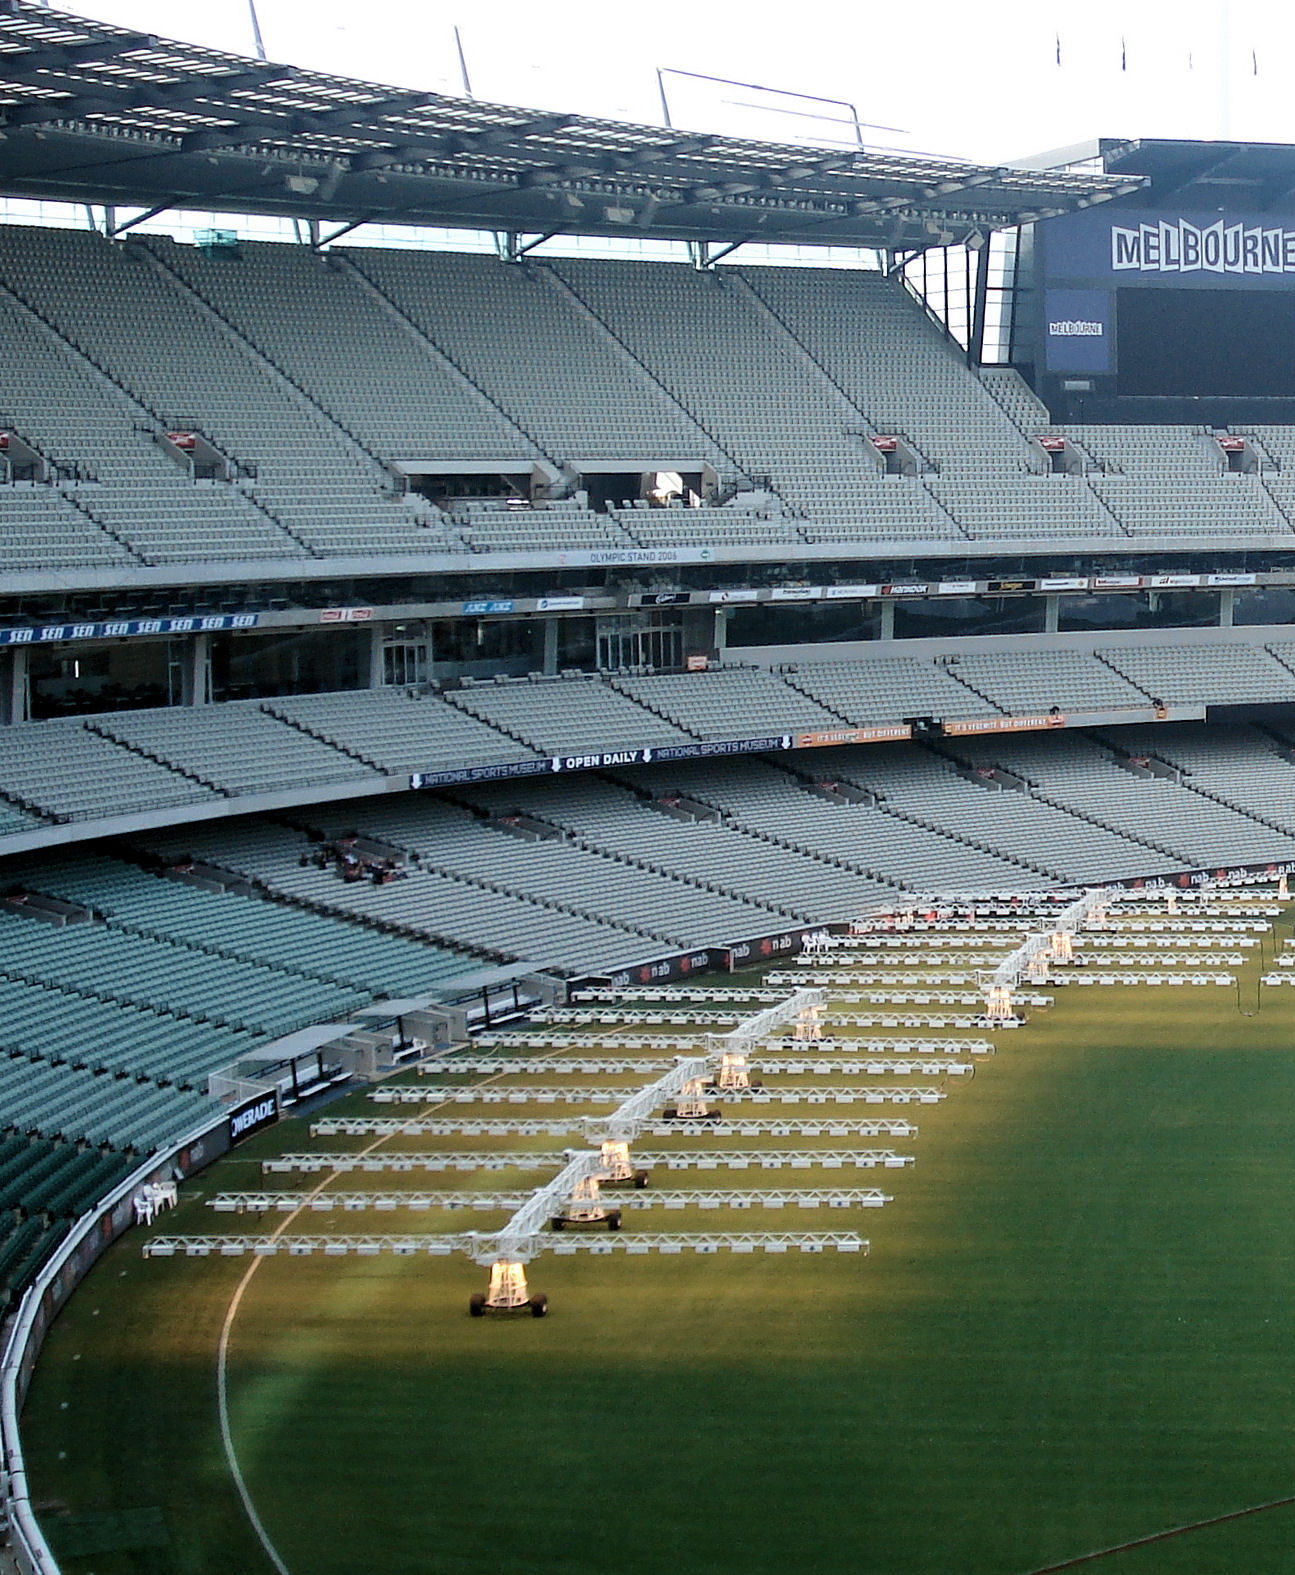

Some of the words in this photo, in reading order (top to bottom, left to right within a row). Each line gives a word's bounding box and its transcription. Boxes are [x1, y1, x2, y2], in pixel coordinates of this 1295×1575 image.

[1050, 320, 1102, 336] MELBOURNE
[590, 551, 626, 563] OLYMPIC
[628, 551, 655, 562] STAND
[9, 630, 33, 642] SEN
[40, 627, 64, 640] SEN
[71, 625, 94, 638] SEN
[104, 622, 128, 635] SEN
[136, 620, 160, 633] SEN
[169, 618, 193, 631] SEN
[201, 617, 225, 629] SEN
[231, 615, 255, 628] SEN
[657, 747, 700, 760] NATIONAL
[701, 743, 739, 755] SPORTS
[740, 738, 778, 751] MUSEUM
[566, 755, 599, 769] OPEN
[603, 751, 637, 765] DAILY
[425, 771, 469, 785] NATIONAL
[471, 767, 508, 781] SPORTS
[508, 762, 546, 776] MUSEUM
[1190, 872, 1210, 883] nab
[772, 935, 792, 950] nab
[690, 953, 709, 968] nab
[651, 962, 670, 977] nab
